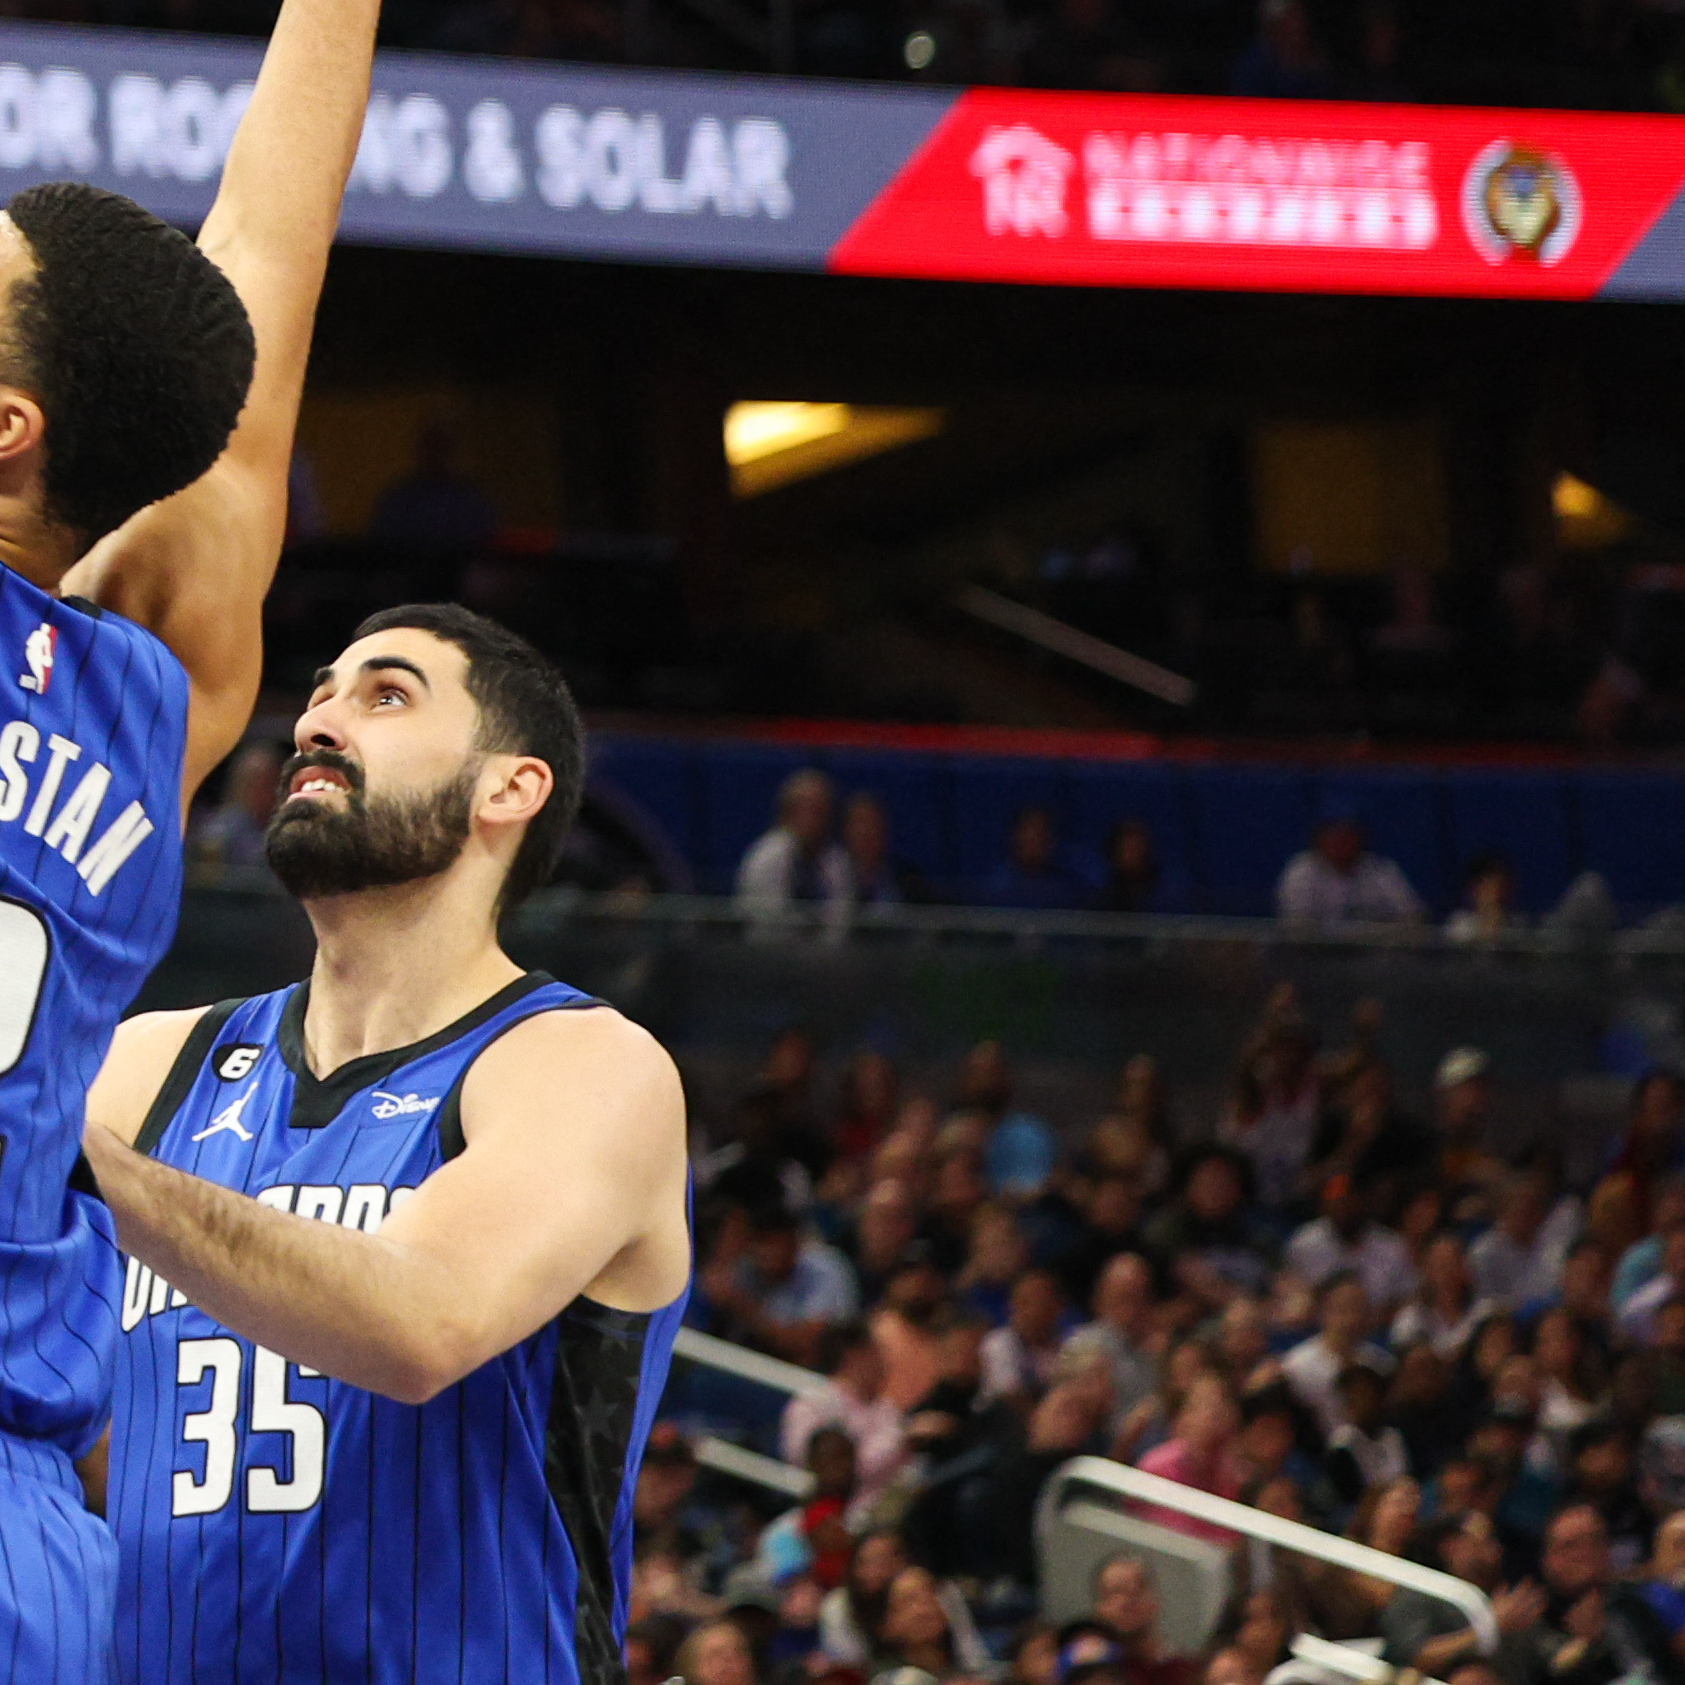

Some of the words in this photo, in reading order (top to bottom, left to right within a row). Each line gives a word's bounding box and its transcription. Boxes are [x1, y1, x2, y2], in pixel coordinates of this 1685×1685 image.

[465, 98, 525, 203] &
[535, 103, 795, 221] SOLAR
[219, 1047, 261, 1080] 6
[171, 1336, 327, 1519] 35
